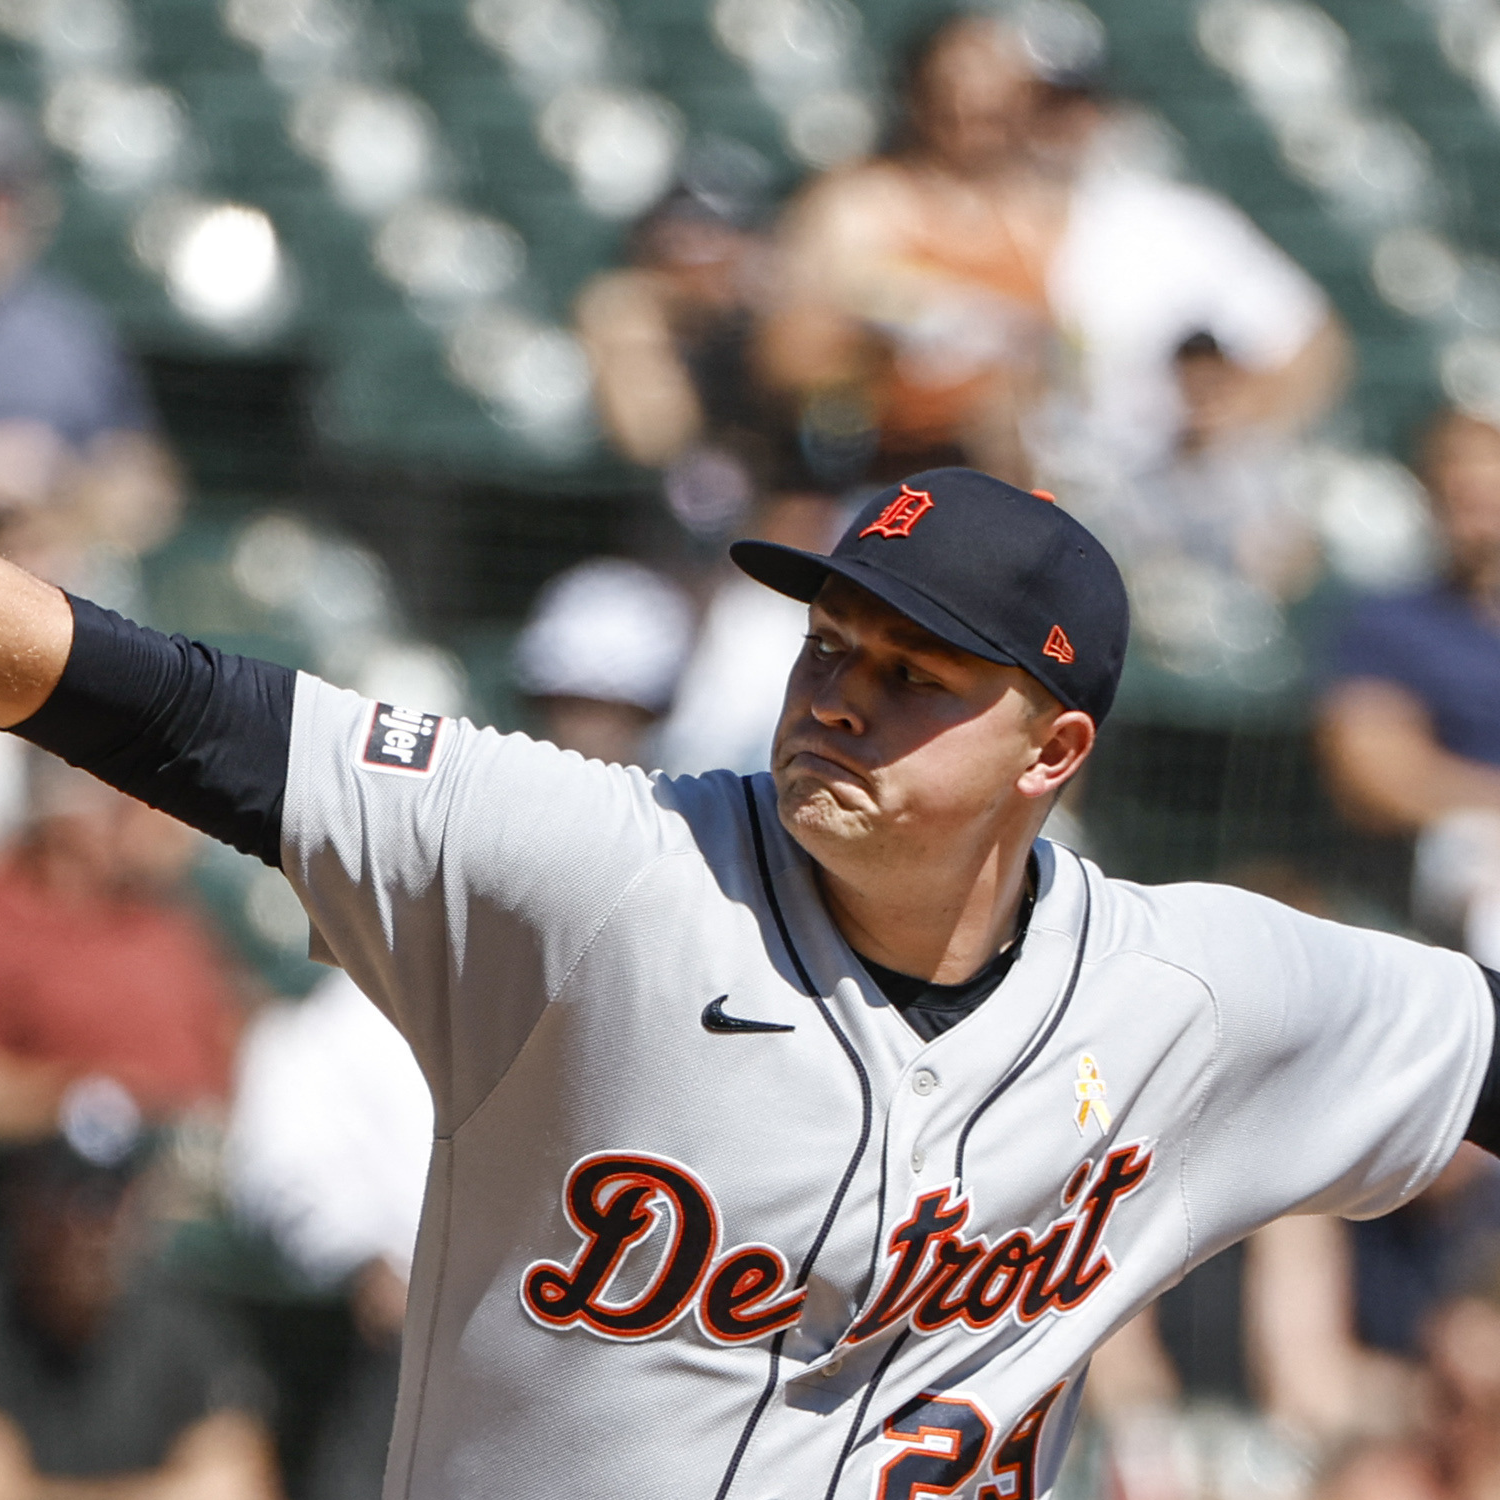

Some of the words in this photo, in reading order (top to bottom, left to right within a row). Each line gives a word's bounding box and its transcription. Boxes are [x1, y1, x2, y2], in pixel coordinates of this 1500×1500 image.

[858, 483, 935, 539] D
[378, 705, 435, 764] ijer
[519, 1136, 1155, 1346] Detroit
